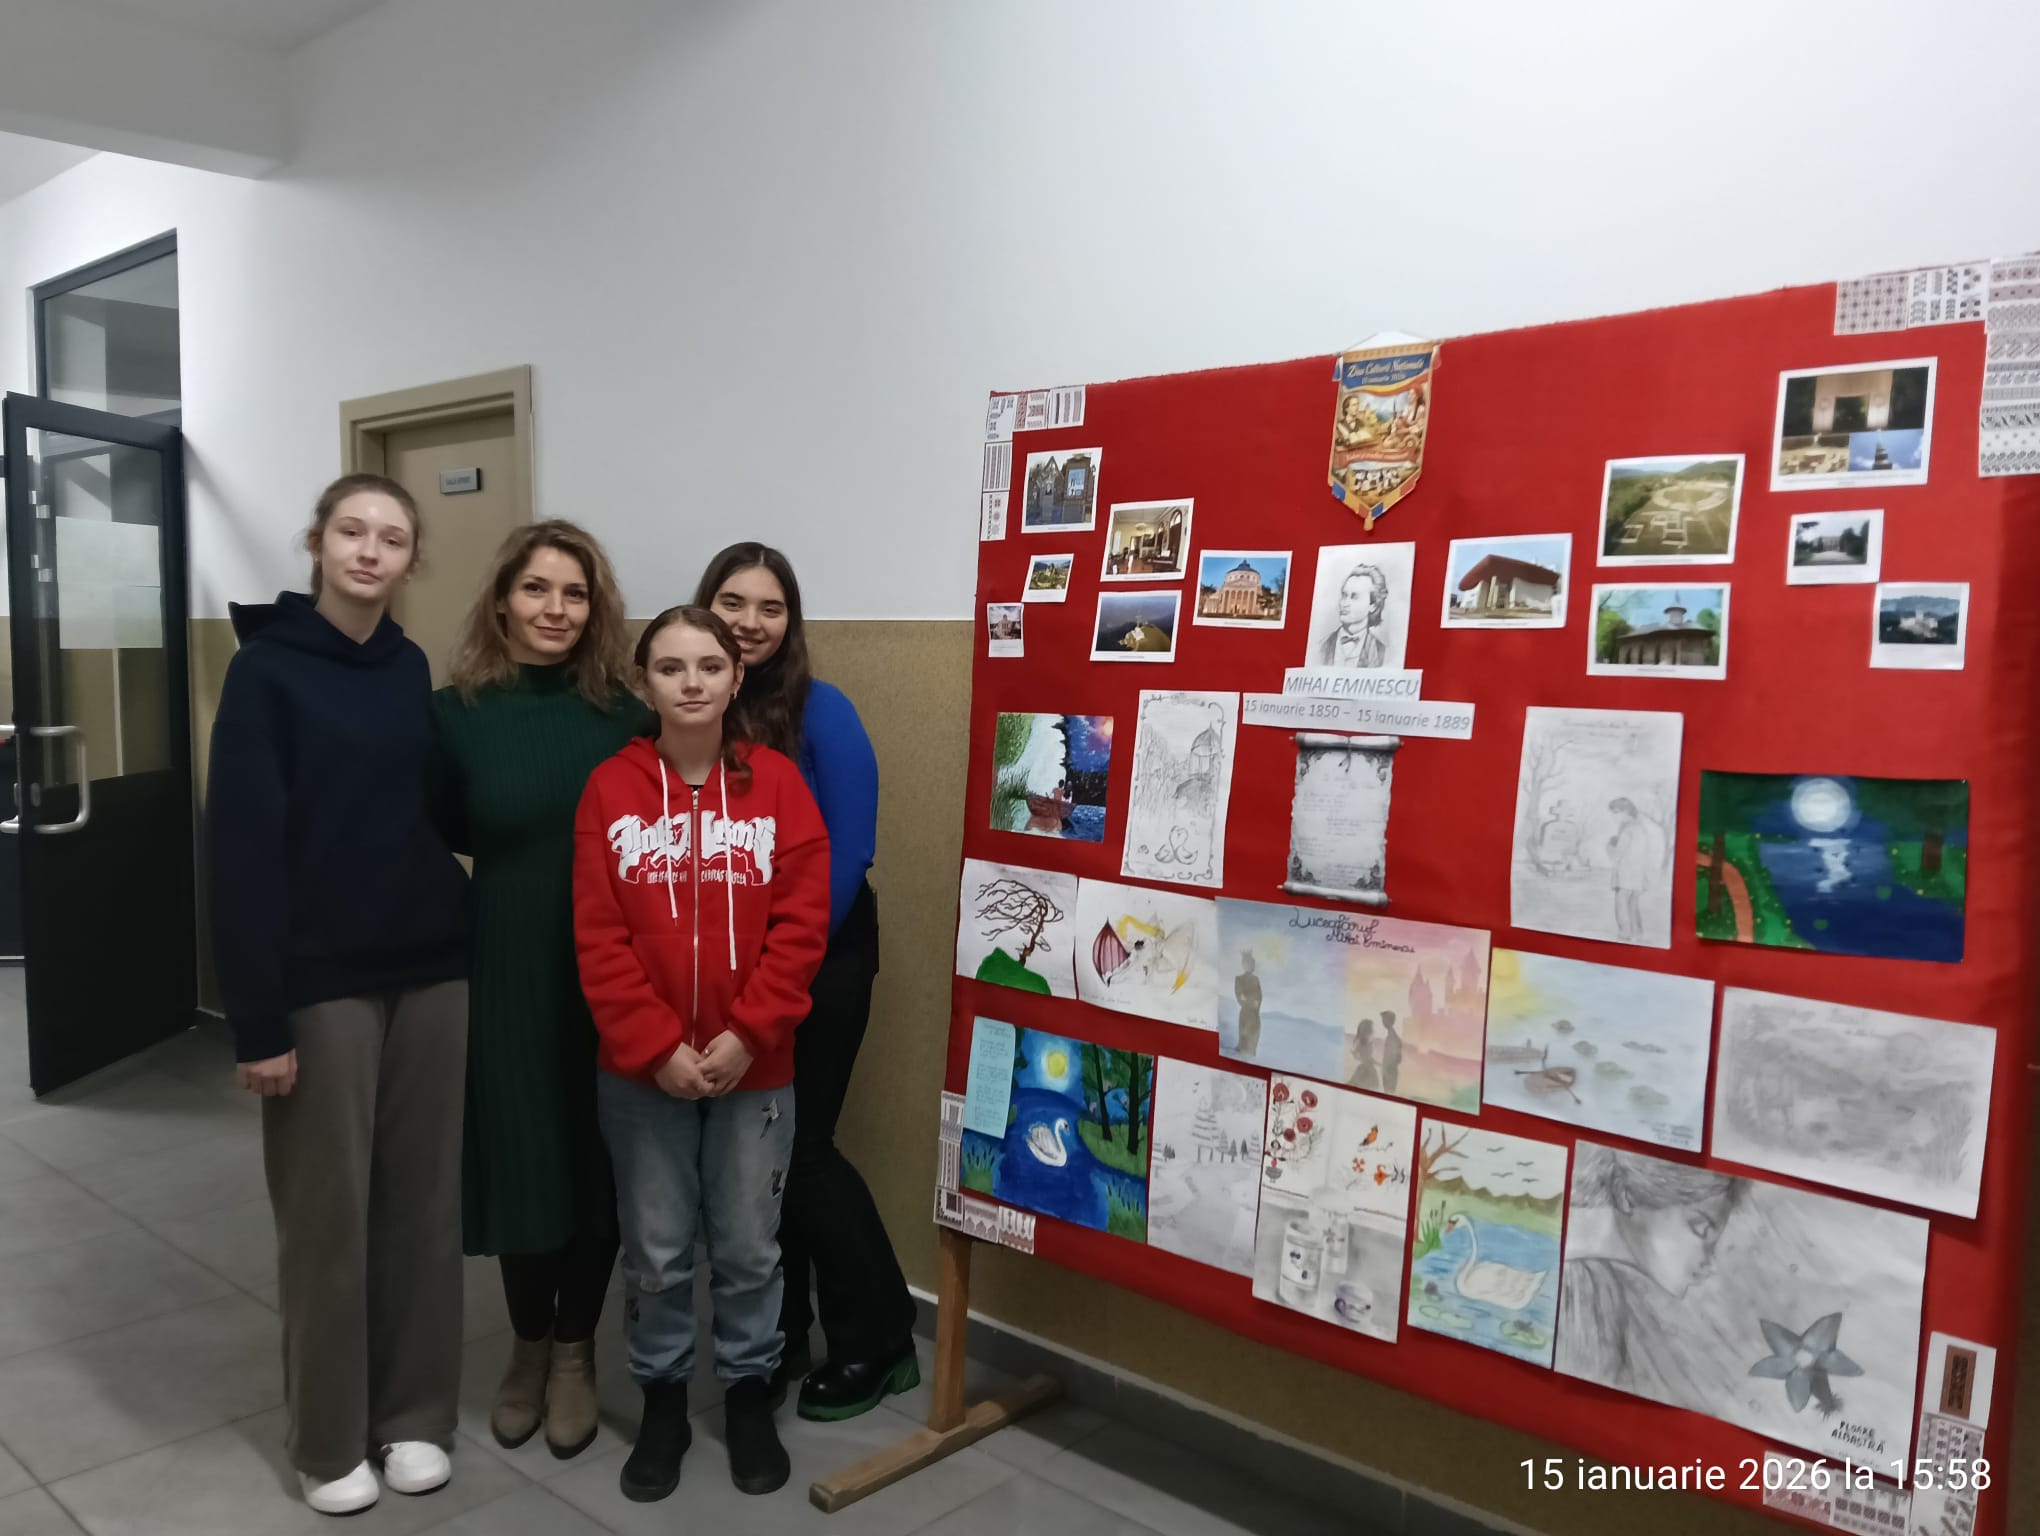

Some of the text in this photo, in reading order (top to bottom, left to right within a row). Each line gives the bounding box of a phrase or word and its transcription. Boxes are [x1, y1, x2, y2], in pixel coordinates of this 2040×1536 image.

[1286, 676, 1419, 696] MIHAI EMINESCU
[1244, 699, 1257, 712] 15
[1260, 700, 1305, 717] ianuarie
[1309, 704, 1340, 718] 1850
[1357, 708, 1372, 722] 15
[1375, 710, 1429, 728] ianuarie
[1433, 714, 1470, 730] 1889
